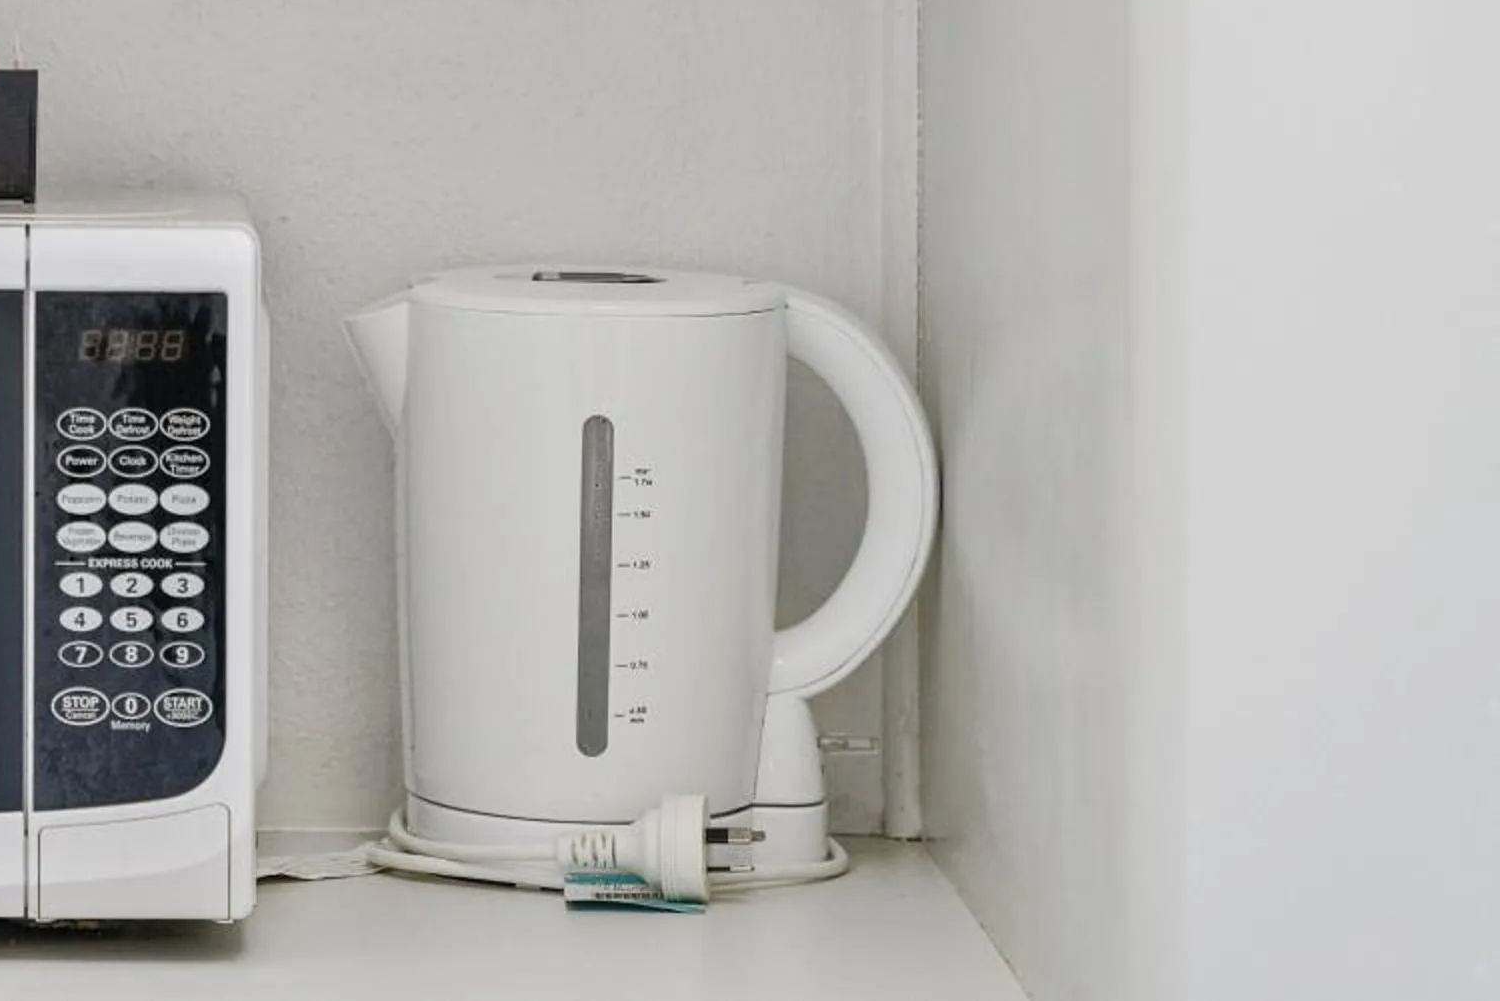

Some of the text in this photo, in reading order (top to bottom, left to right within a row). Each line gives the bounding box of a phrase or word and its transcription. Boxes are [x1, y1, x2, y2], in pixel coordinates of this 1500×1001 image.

[65, 454, 100, 467] Power
[119, 455, 148, 467] Clock
[87, 558, 173, 569] EXPRESS COOK
[75, 577, 86, 594] 1
[125, 578, 138, 594] 2
[176, 578, 190, 594] 3
[73, 612, 86, 627] 4
[125, 612, 138, 628] 5
[176, 612, 189, 628] 6
[74, 646, 87, 663] 7
[124, 646, 139, 663] 8
[175, 646, 190, 664] 9
[62, 697, 100, 709] STOP
[125, 698, 138, 714] 0
[163, 696, 203, 711] START
[110, 720, 151, 732] Memory
